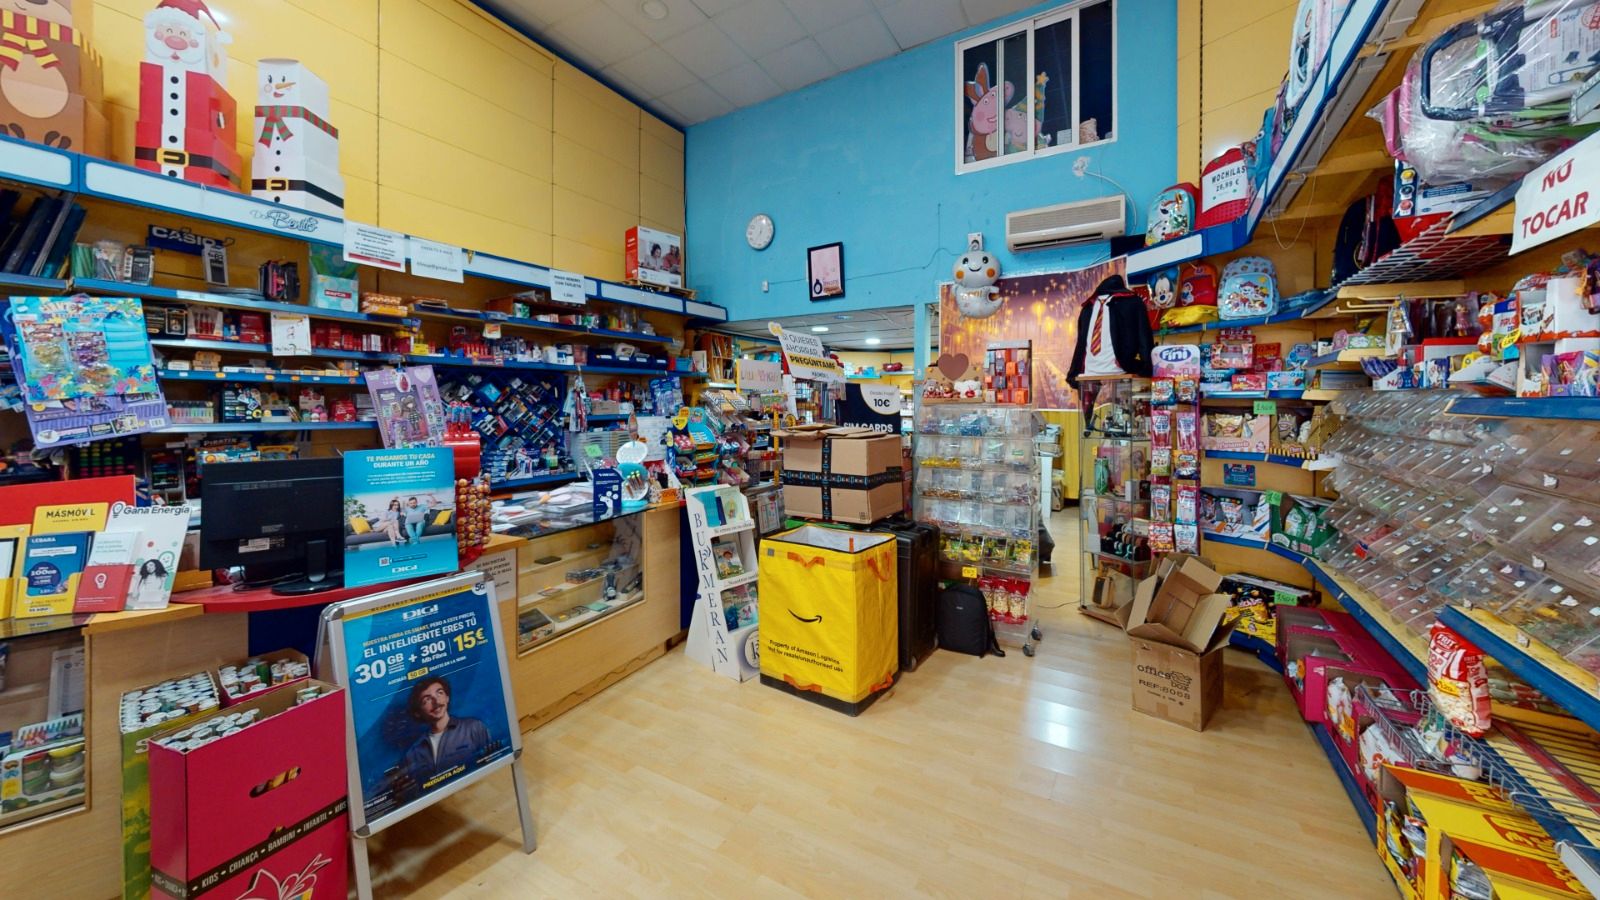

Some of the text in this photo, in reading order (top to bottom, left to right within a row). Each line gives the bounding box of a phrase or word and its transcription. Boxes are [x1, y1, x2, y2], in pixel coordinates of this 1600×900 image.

[1541, 158, 1575, 192] NO
[1521, 191, 1590, 240] TOCAR
[151, 226, 217, 248] CASIO
[874, 398, 891, 408] 10€
[860, 423, 894, 433] CARDS
[373, 461, 404, 469] DURANTE
[123, 505, 190, 516] Gana Energía
[402, 604, 439, 620] DIGI
[364, 616, 477, 659] EL INTELIGENTE ERES TÚ
[354, 659, 387, 684] 30
[387, 653, 405, 665] GB
[420, 640, 446, 657] 300
[453, 627, 485, 652] 15€
[769, 639, 790, 650] Property
[796, 647, 817, 657] Amazon
[421, 656, 432, 665] Mb
[432, 652, 447, 661] Fibra
[1137, 664, 1171, 680] office
[422, 772, 452, 789] PREGUNTA
[201, 871, 219, 888] KIDS
[228, 849, 259, 874] CRIANÇA
[267, 829, 296, 852] BAMBINI
[303, 812, 328, 832] INFANTIL
